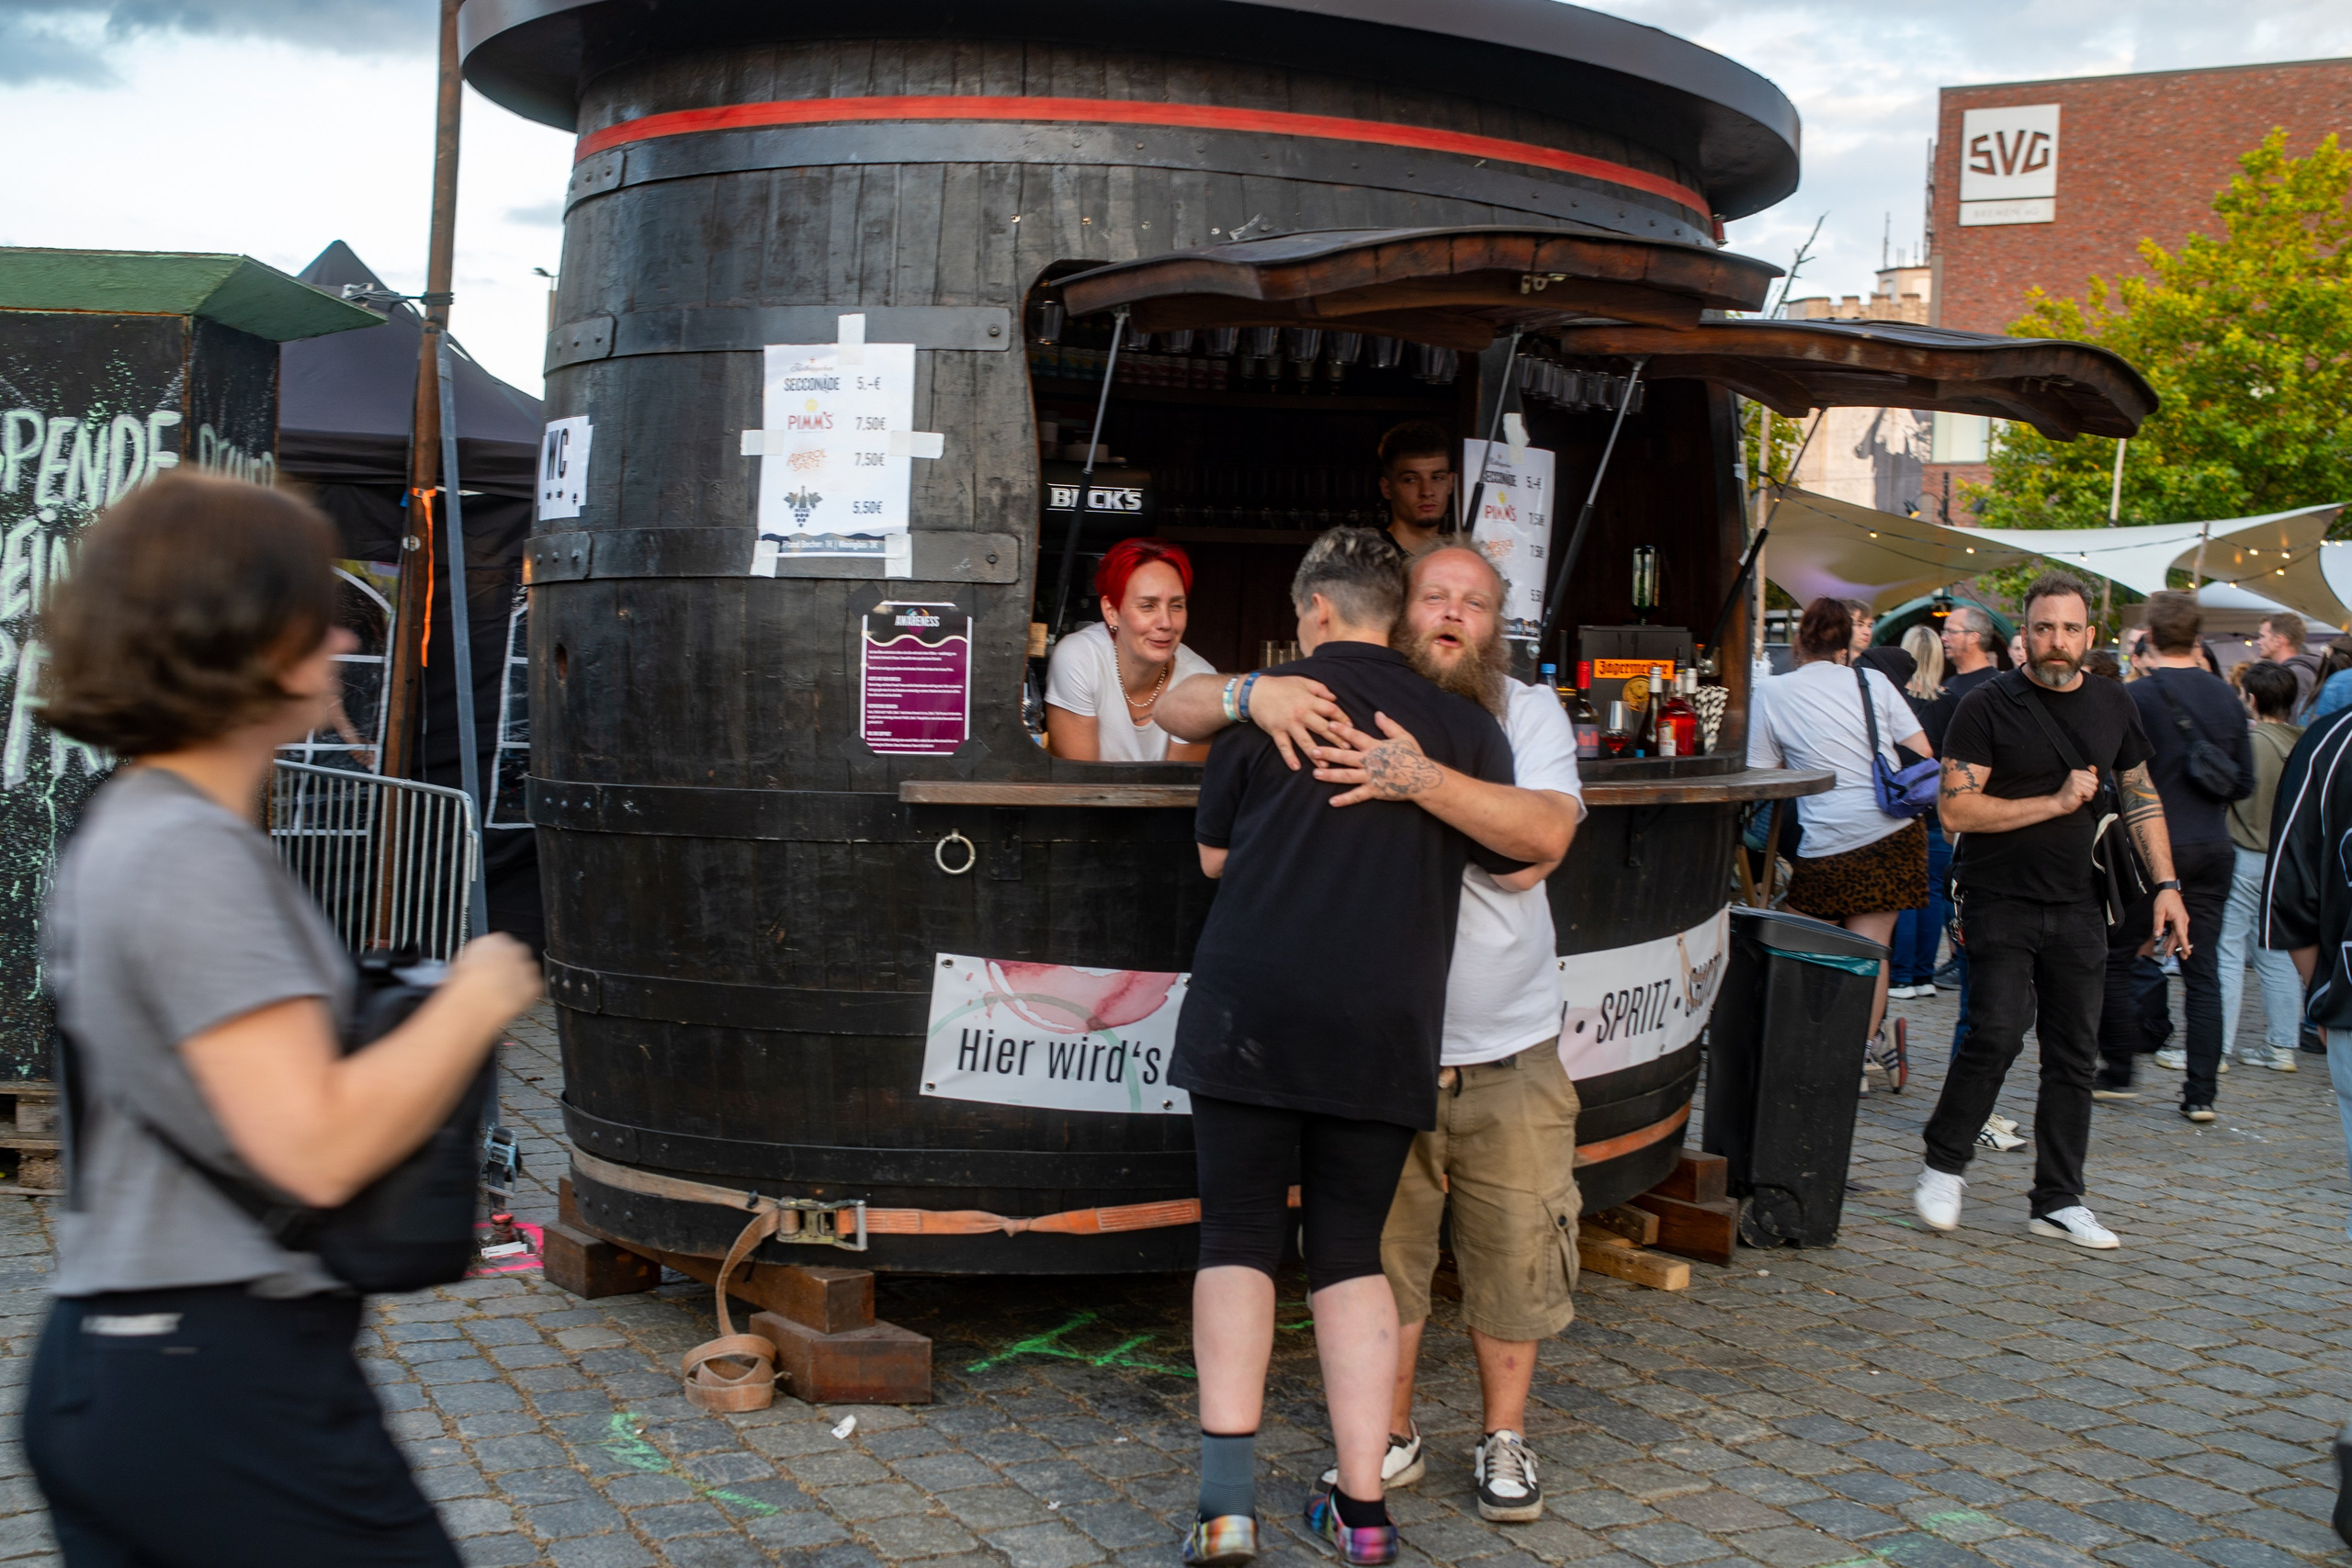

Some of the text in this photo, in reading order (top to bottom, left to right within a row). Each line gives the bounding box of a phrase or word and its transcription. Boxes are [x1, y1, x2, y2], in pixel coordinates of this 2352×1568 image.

[1969, 130, 2050, 175] SVG
[855, 416, 887, 431] 7,50€
[854, 452, 886, 467] 7,50€
[853, 501, 883, 514] 5,50€
[1050, 487, 1142, 511] BCK'S
[1596, 978, 1671, 1044] SPRITZ
[956, 1028, 1162, 1086] Hier wird's
